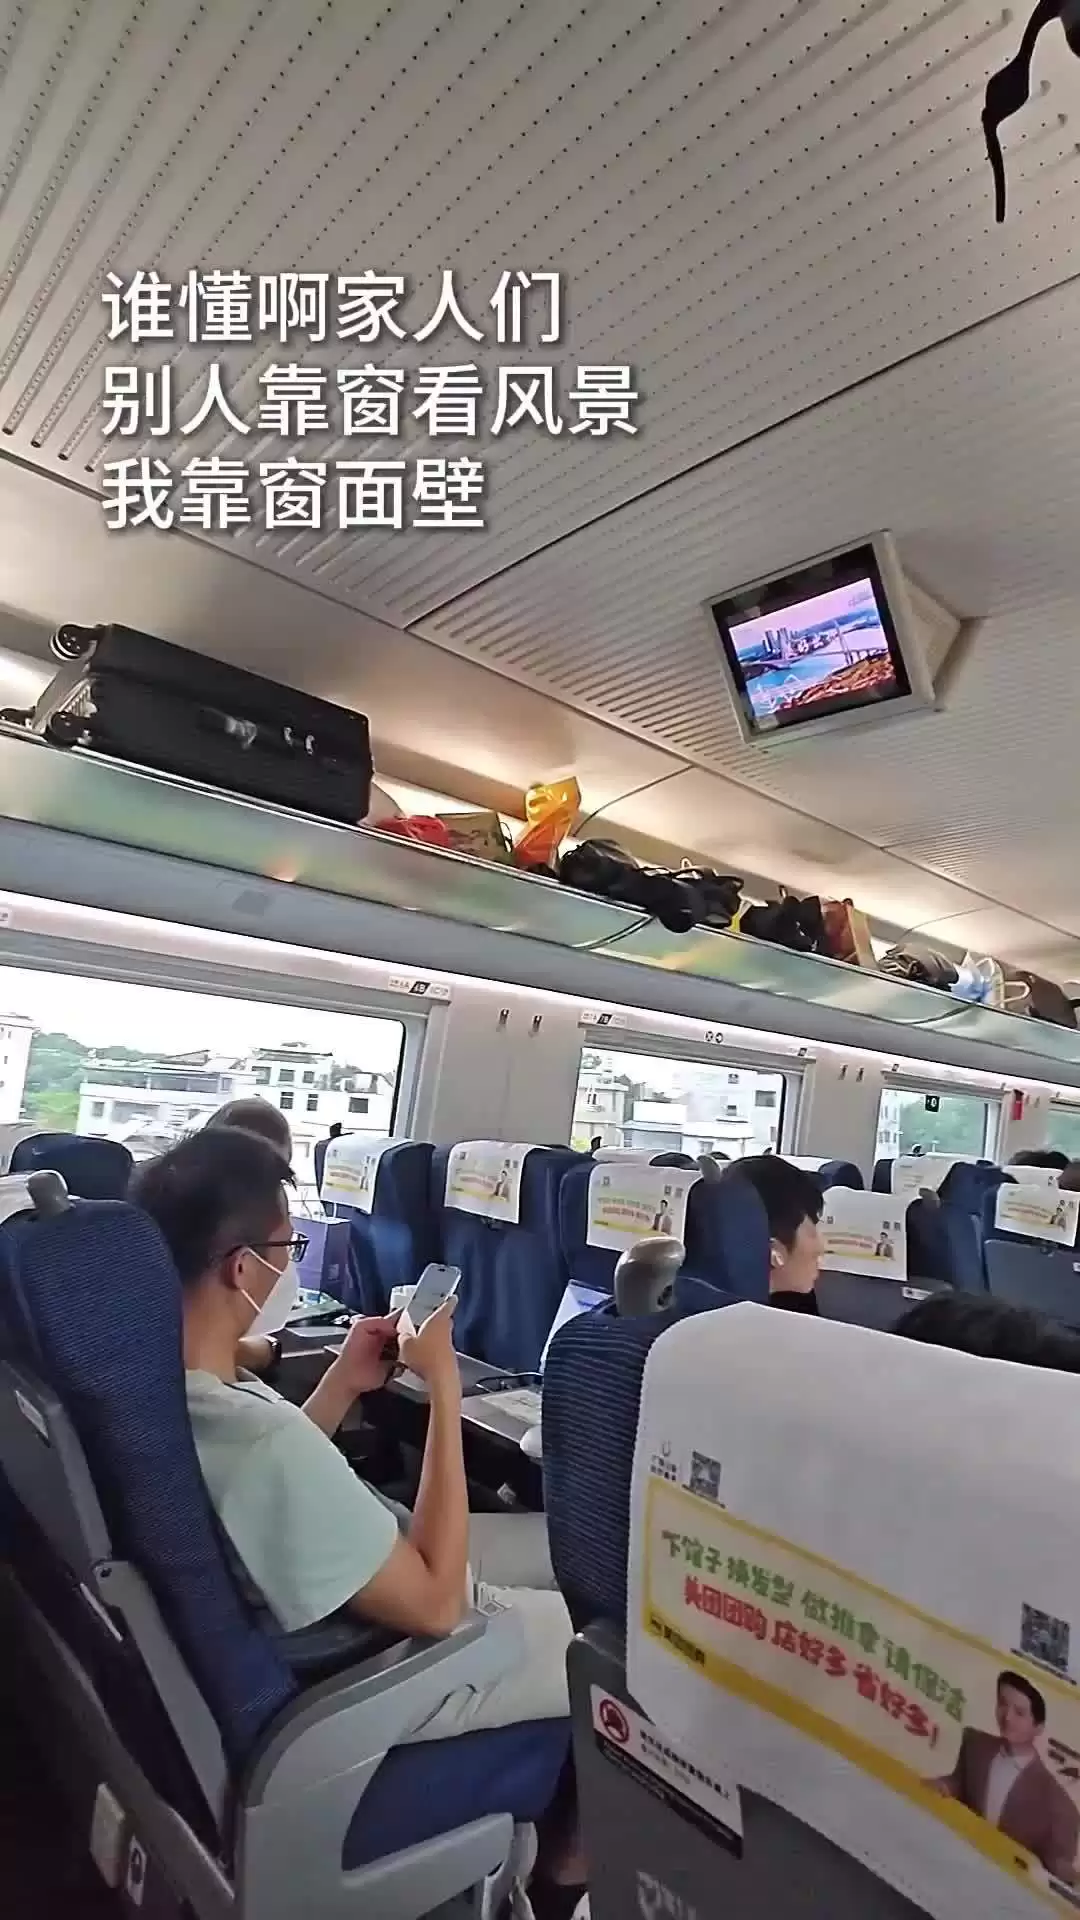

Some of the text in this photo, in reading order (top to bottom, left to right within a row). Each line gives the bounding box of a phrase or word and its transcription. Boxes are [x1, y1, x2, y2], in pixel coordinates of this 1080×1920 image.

[685, 1575, 767, 1640] 美团团购
[771, 1620, 847, 1677] 店好多
